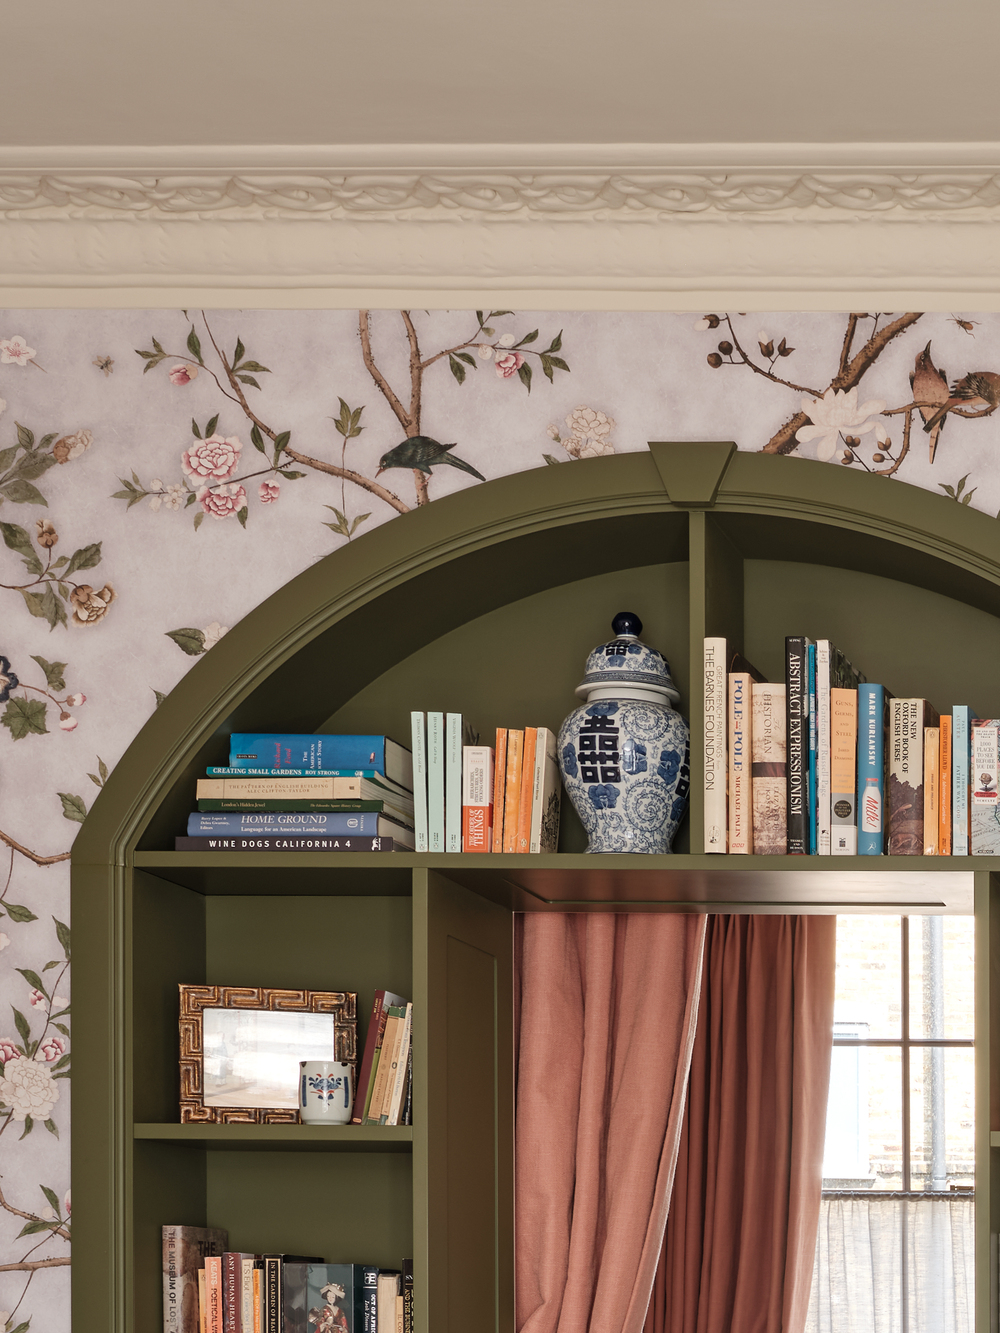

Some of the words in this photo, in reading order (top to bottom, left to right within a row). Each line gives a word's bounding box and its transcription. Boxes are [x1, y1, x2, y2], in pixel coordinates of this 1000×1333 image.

[705, 646, 715, 668] THE
[705, 671, 715, 711] BARNES
[789, 652, 801, 716] ABSTRACT
[734, 680, 743, 720] POLE
[868, 692, 876, 716] MARK
[763, 693, 772, 754] HISTORIAN
[705, 715, 715, 790] FOUNDATION
[734, 731, 743, 772] POLE
[821, 737, 828, 747] of
[868, 719, 876, 766] KURLANSKY
[213, 767, 247, 775] CREATING
[789, 720, 801, 815] EXPRESSIONISM
[902, 762, 909, 774] OF
[241, 815, 275, 824] HOME
[277, 815, 327, 824] GROUND
[865, 795, 880, 828] Milk!
[474, 809, 484, 846] THINGS
[209, 840, 236, 848] WINE
[242, 840, 270, 848] DOGS
[275, 840, 340, 848] CALIFORNIA
[345, 840, 351, 848] 4
[168, 1231, 176, 1248] THE
[168, 1250, 176, 1290] MUSEUM
[210, 1261, 218, 1285] KEATS
[168, 1292, 176, 1304] OF
[210, 1288, 218, 1323] POETICAL
[168, 1306, 176, 1328] LOST
[270, 1308, 276, 1317] OF
[370, 1306, 376, 1315] OF
